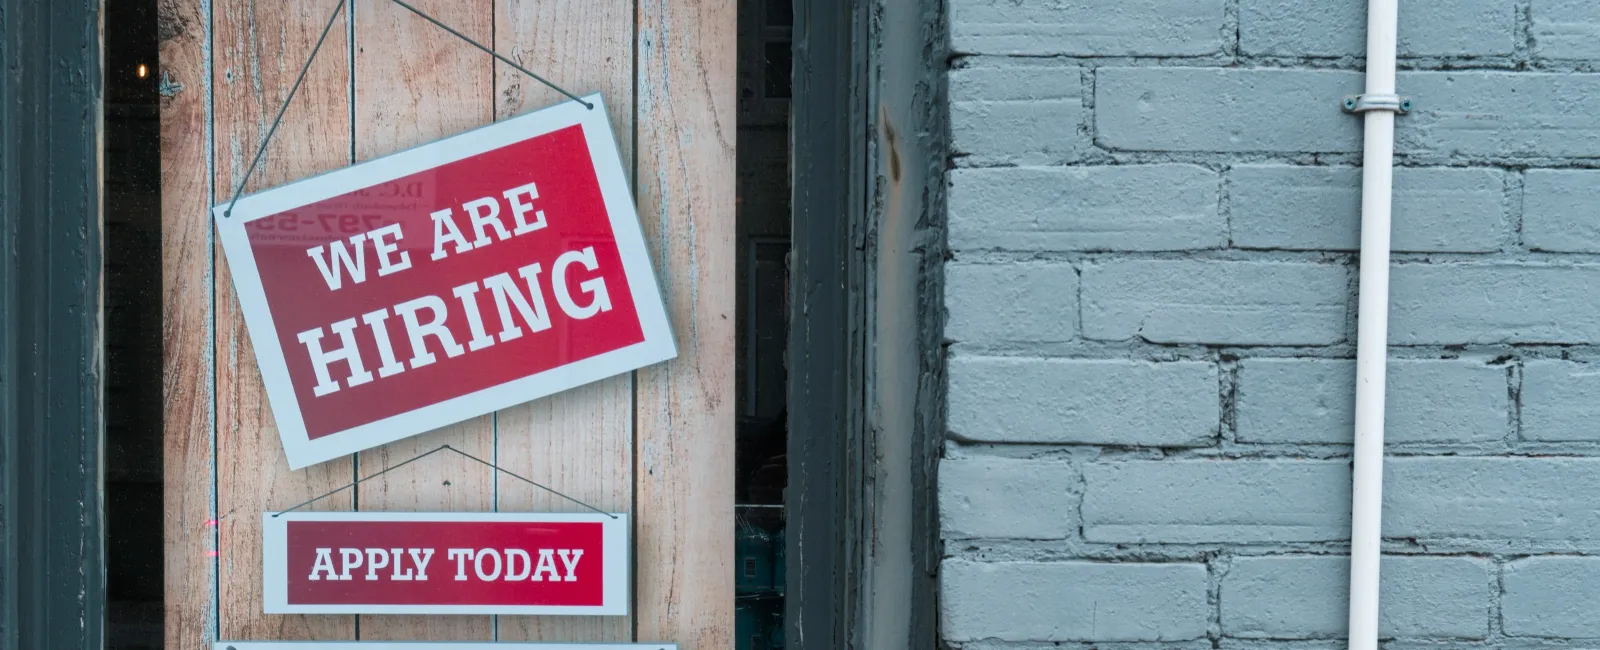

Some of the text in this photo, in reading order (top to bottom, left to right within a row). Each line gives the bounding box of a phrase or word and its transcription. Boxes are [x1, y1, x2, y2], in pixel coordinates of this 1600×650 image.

[307, 182, 547, 291] WE ARE
[297, 246, 612, 397] HIRING
[308, 547, 584, 582] APPLY TODAY
